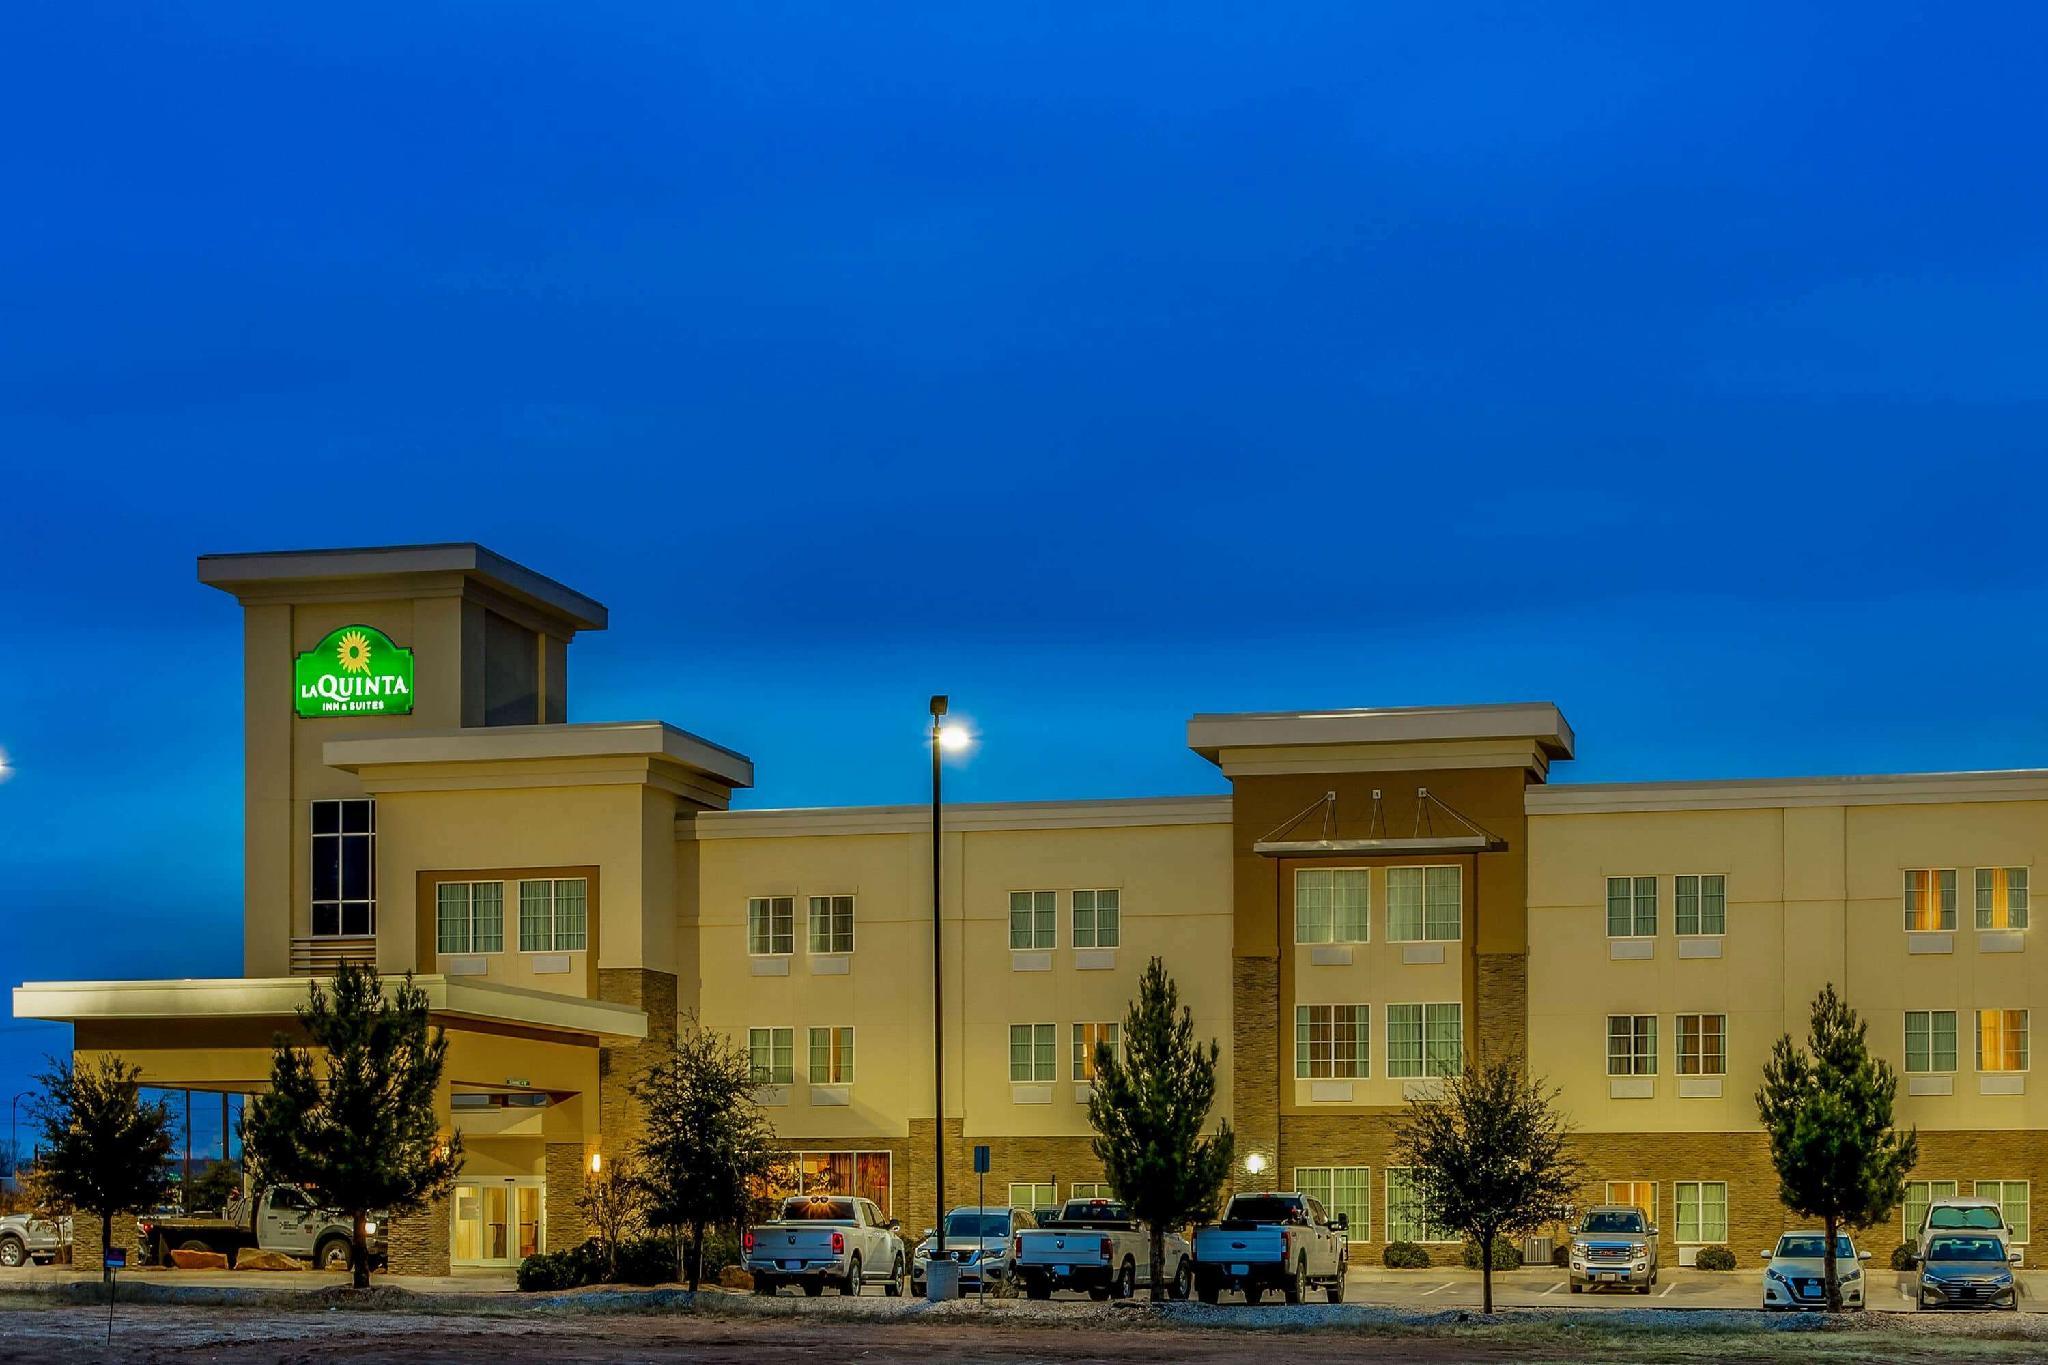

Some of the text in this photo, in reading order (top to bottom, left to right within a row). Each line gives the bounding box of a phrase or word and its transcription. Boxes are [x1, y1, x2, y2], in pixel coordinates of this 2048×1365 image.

[302, 674, 409, 702] LA QUINTA
[322, 702, 339, 711] INN
[350, 701, 384, 711] SUITES
